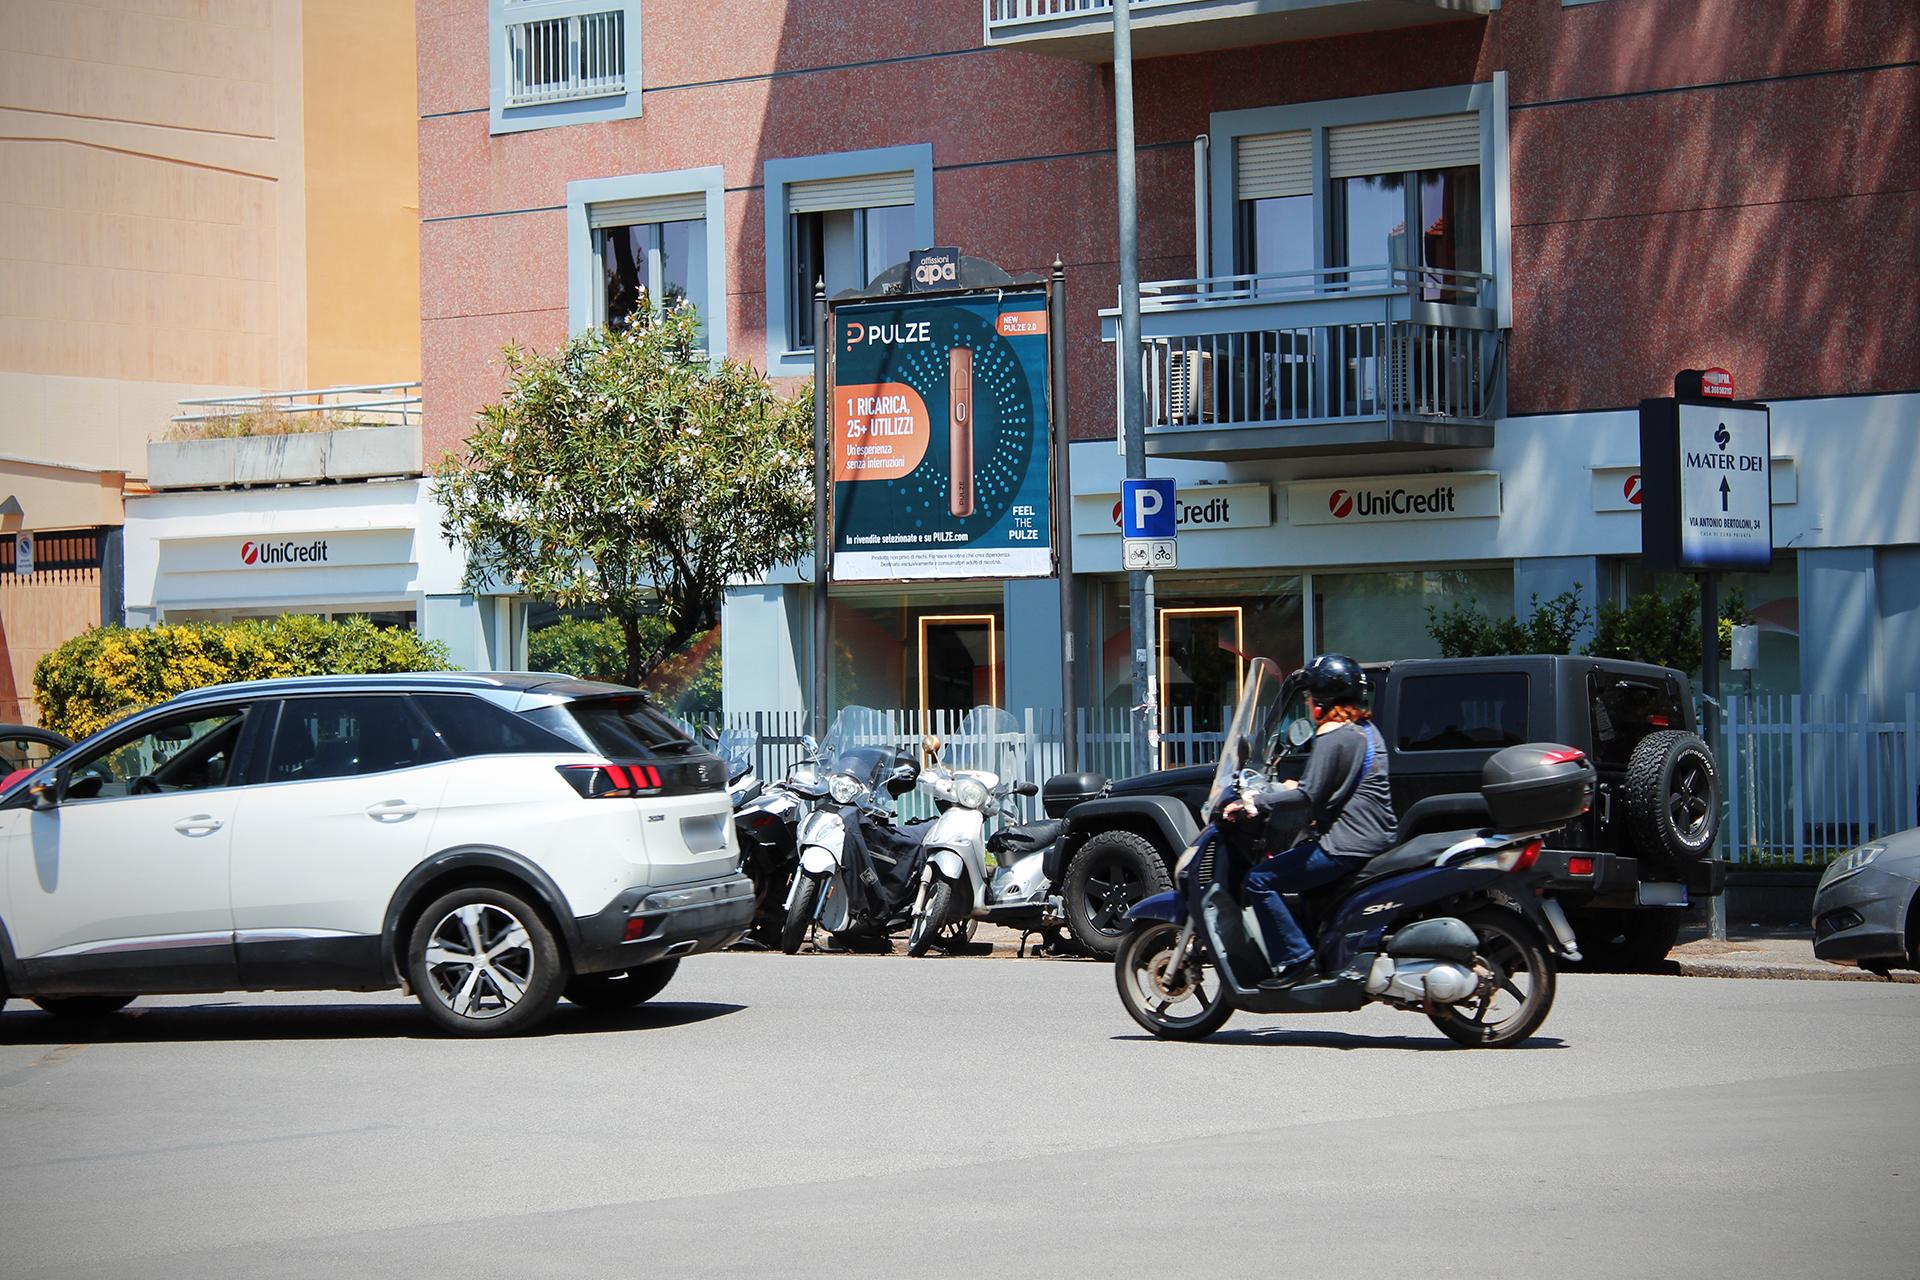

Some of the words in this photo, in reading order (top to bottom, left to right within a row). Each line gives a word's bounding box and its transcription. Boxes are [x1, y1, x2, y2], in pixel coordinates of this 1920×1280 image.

[921, 255, 949, 265] affissioni
[915, 263, 956, 285] apa
[1004, 316, 1018, 324] NEW
[1004, 324, 1026, 332] PULZE
[1028, 322, 1037, 331] 2.0
[868, 322, 931, 346] PULZE
[847, 398, 853, 416] 1
[857, 395, 911, 416] RICARICA,
[847, 419, 868, 438] 25+
[870, 416, 914, 436] UTILIZZI
[846, 442, 892, 458] Un'esperienza
[846, 460, 866, 470] senza
[867, 456, 905, 469] interruzioni
[1686, 452, 1736, 470] MATER
[1740, 455, 1762, 472] DEI
[1135, 489, 1163, 528] P
[1357, 486, 1455, 516] UniCredit
[1012, 506, 1036, 516] FEEL
[1014, 518, 1032, 528] THE
[1690, 517, 1698, 527] VIA
[1700, 518, 1722, 528] ANTONIO
[1724, 518, 1753, 530] BERTOLONI,
[1754, 520, 1761, 530] 34
[854, 534, 881, 544] rivendite
[882, 533, 918, 544] selezionate
[918, 534, 922, 542] e
[924, 534, 932, 542] su
[932, 532, 969, 542] PULZE.com
[1008, 530, 1039, 540] PULZE
[260, 540, 328, 564] UniCredit
